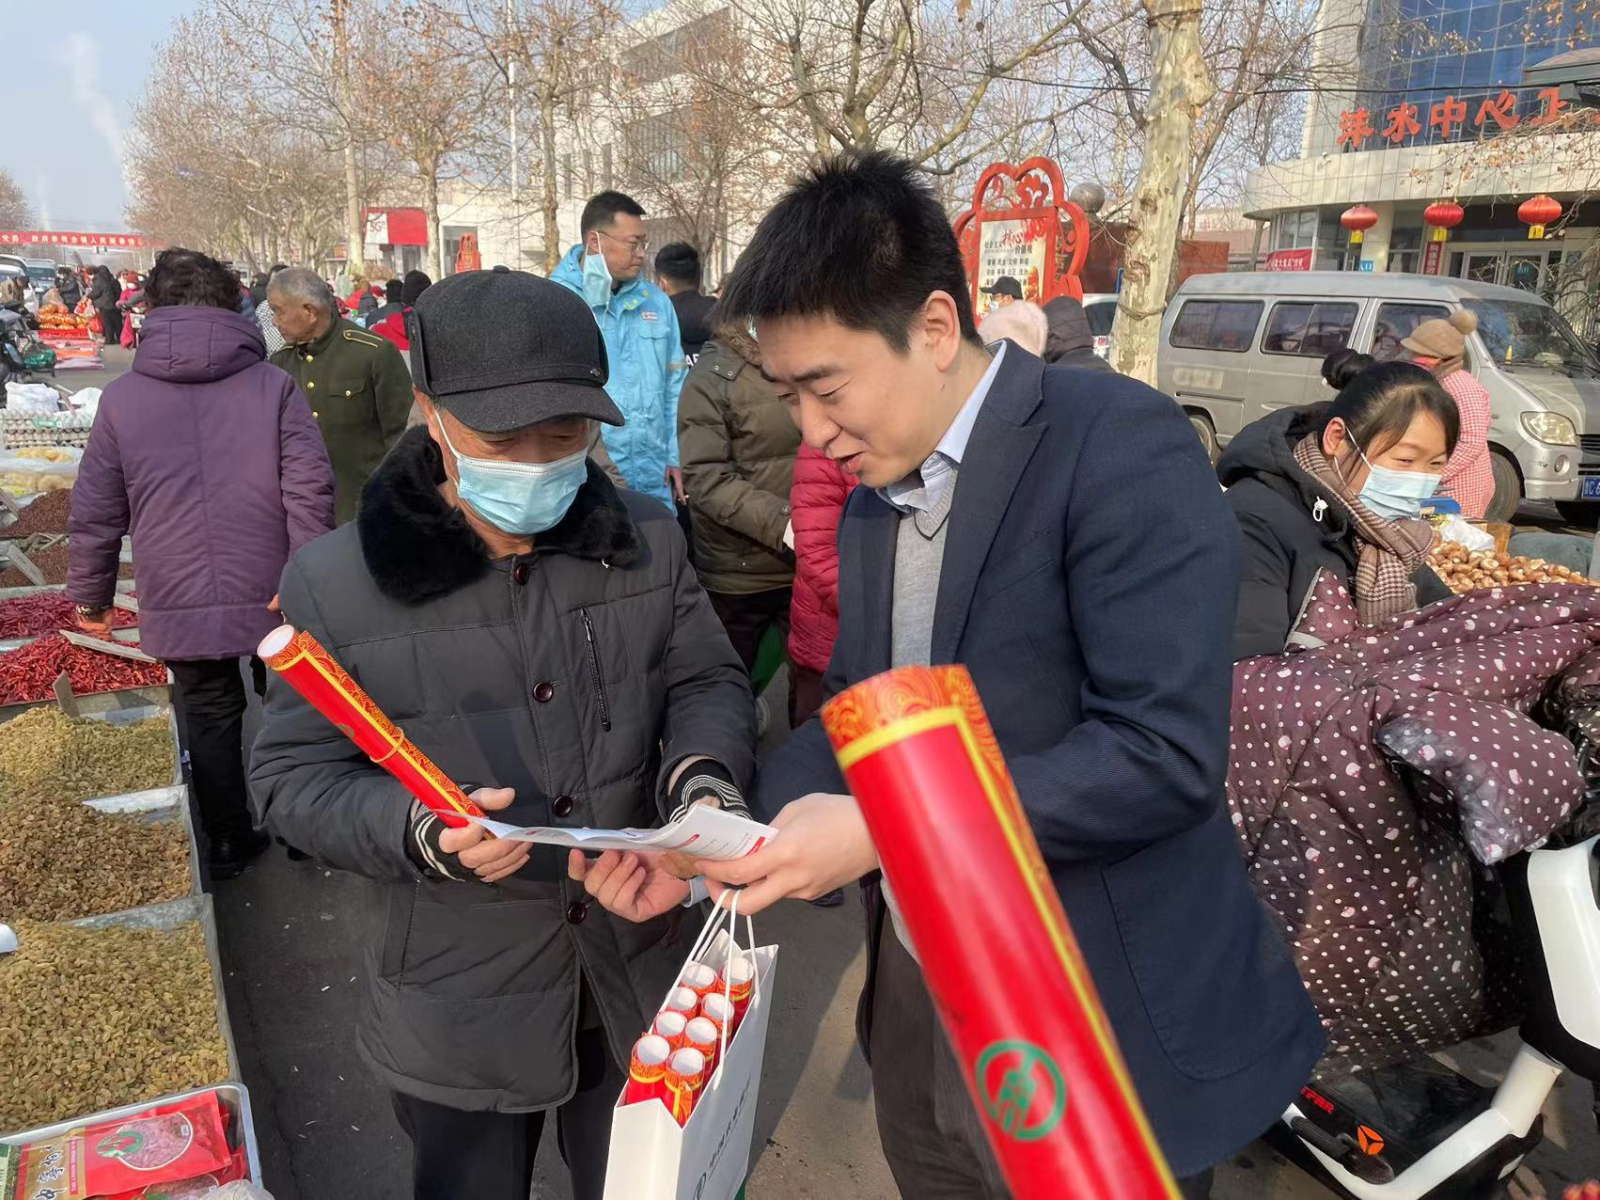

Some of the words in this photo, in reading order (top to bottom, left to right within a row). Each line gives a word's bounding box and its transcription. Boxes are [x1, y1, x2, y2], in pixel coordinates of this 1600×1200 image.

[1337, 89, 1600, 147] 沣水中心卫
